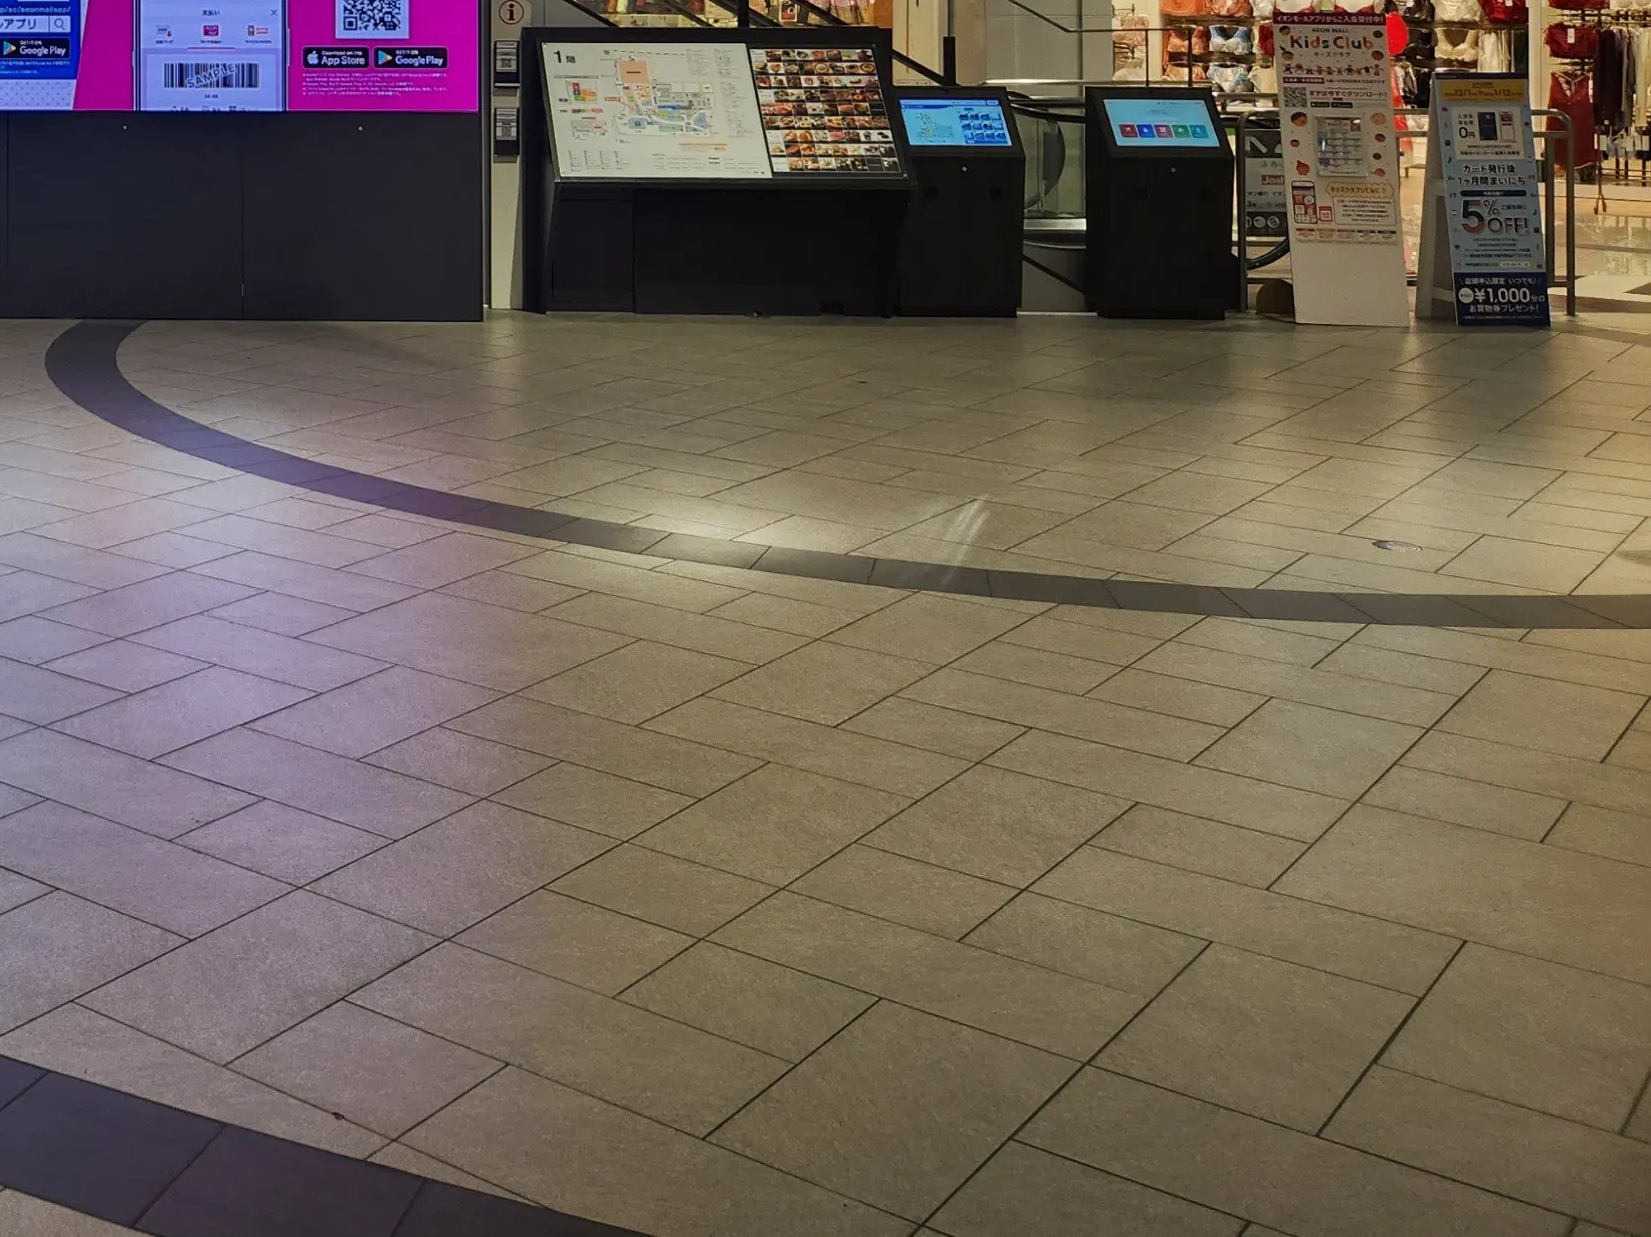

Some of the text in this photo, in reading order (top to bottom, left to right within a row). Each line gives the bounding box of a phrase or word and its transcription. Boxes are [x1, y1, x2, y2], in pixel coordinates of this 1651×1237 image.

[1290, 35, 1374, 50] Kids Club
[19, 46, 66, 57] Google Play
[321, 56, 365, 66] App Store
[395, 55, 444, 66] Google Play
[186, 63, 237, 89] SAMPLE
[1458, 126, 1476, 139] 0円
[1463, 164, 1516, 174] カード発行後
